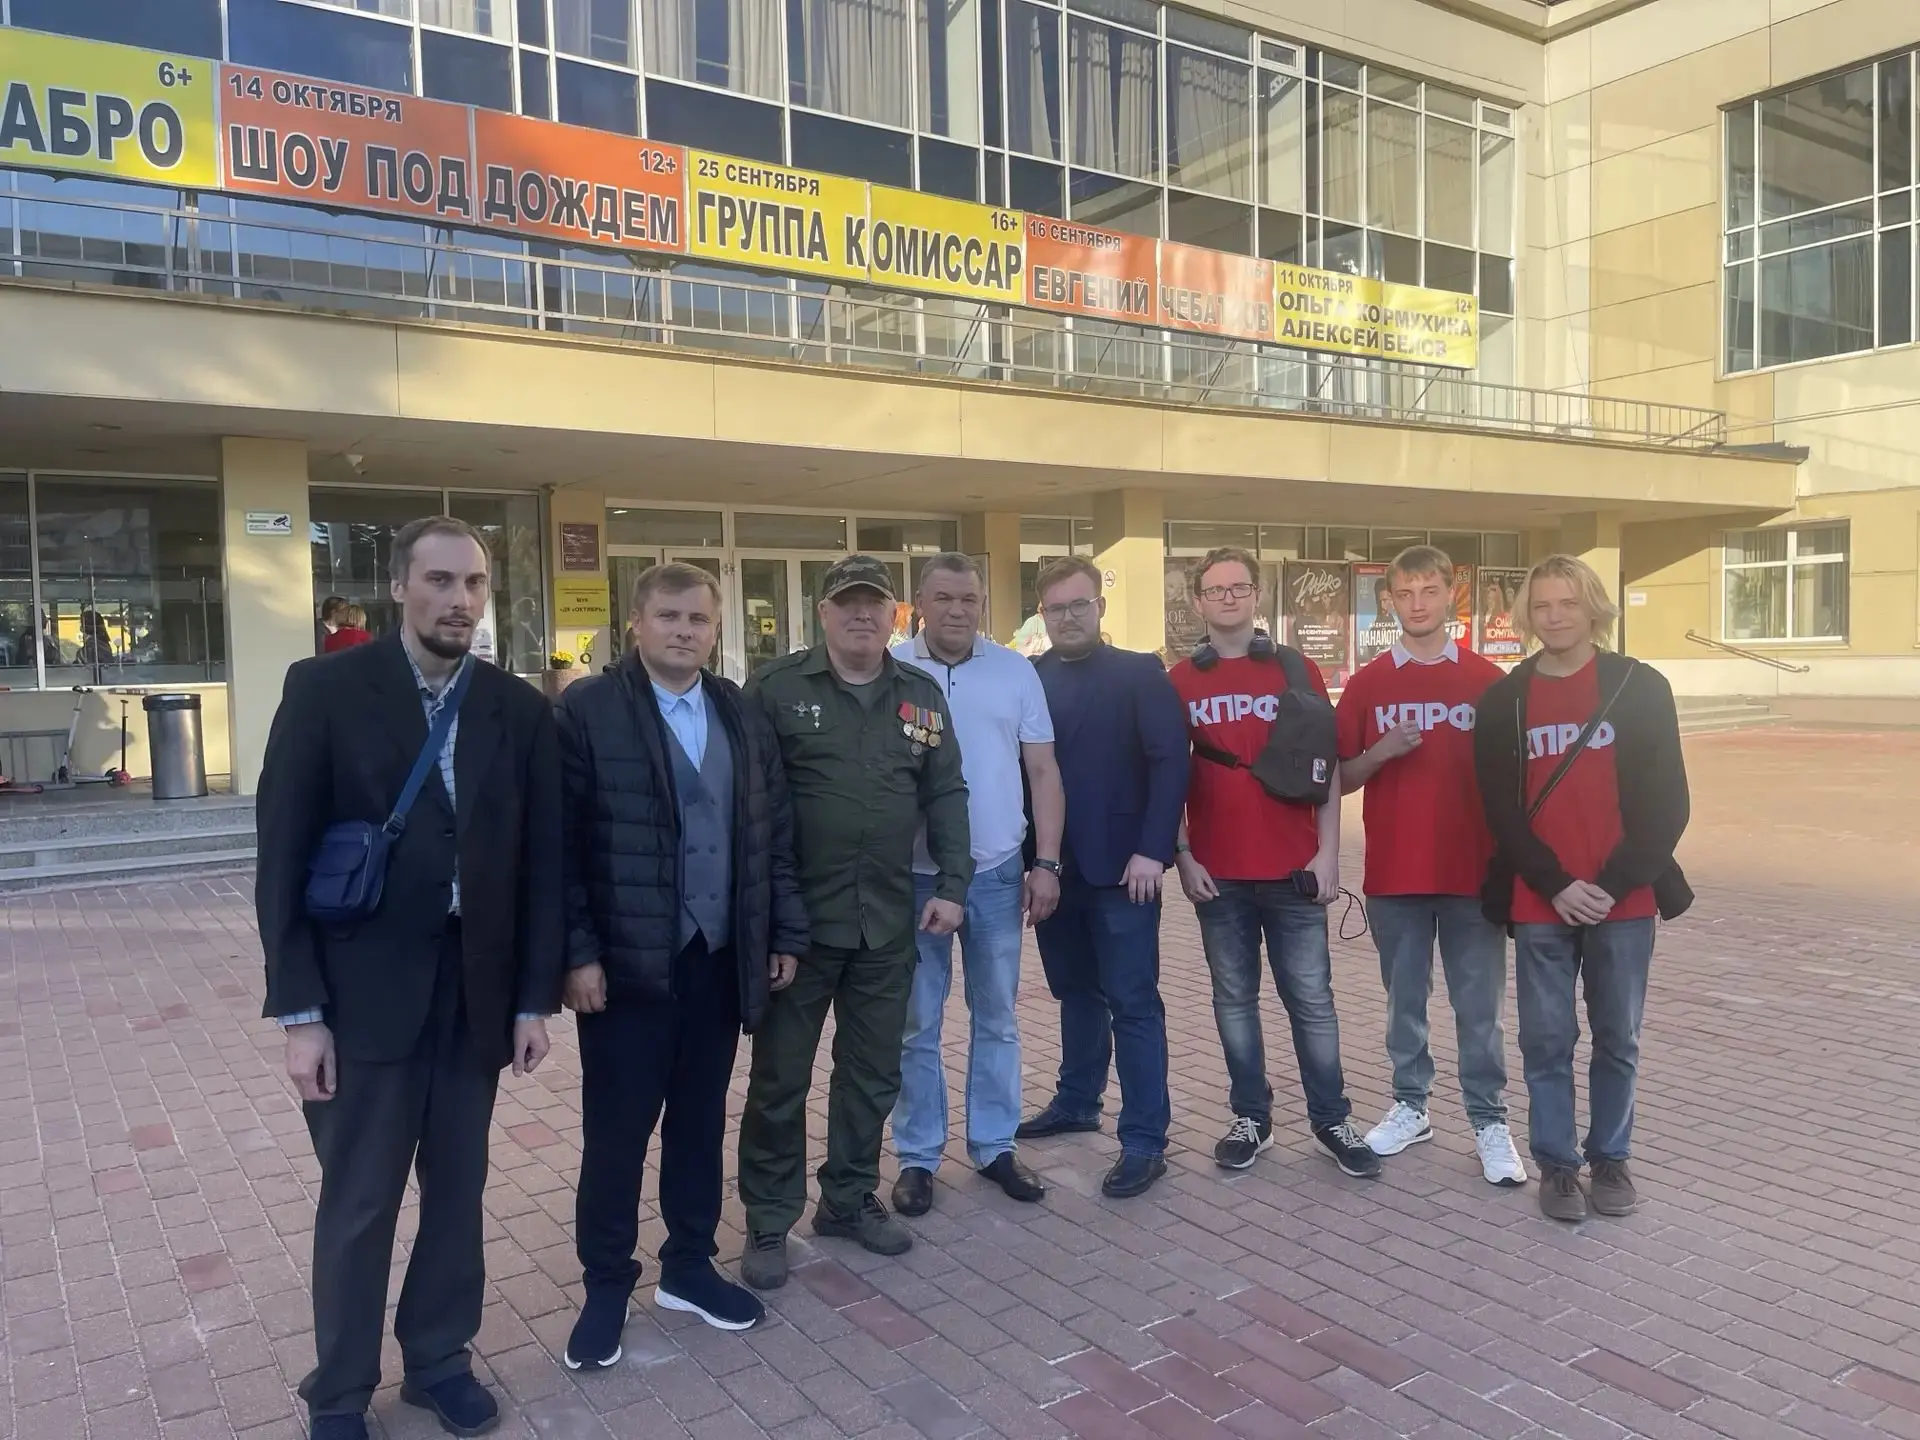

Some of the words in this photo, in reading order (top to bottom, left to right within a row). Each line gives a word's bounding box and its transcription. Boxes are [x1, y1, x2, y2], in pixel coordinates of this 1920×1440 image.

[157, 61, 193, 88] 6+
[230, 72, 263, 101] 14
[271, 79, 403, 124] ОКТЯБРЯ
[0, 81, 185, 169] АБРО
[640, 148, 677, 175] 12+
[697, 158, 720, 179] 25
[725, 163, 821, 197] СЕНТЯБРЯ
[229, 123, 350, 193] ШОУ
[365, 143, 472, 218] ПОД
[484, 164, 679, 245] ДОЖДЕМ
[989, 210, 1019, 233] 16+
[1030, 219, 1046, 238] 16
[1050, 224, 1121, 252] СЕНТЯБРЯ
[696, 189, 830, 263] ГРУППА
[844, 213, 1023, 291] КОМИССАР
[1032, 264, 1150, 317] ЕВГЕНИЙ
[1161, 285, 1269, 333] ЧЕБАТОВ
[1280, 269, 1295, 286] 11
[1299, 272, 1353, 295] ОКТЯБРЯ
[1356, 301, 1472, 337] КОРМУХИНА
[1455, 296, 1472, 313] 12+
[1281, 317, 1379, 349] АЛЕКСЕЙ
[1188, 694, 1280, 727] КПРФ
[1375, 702, 1476, 735] КПРФ
